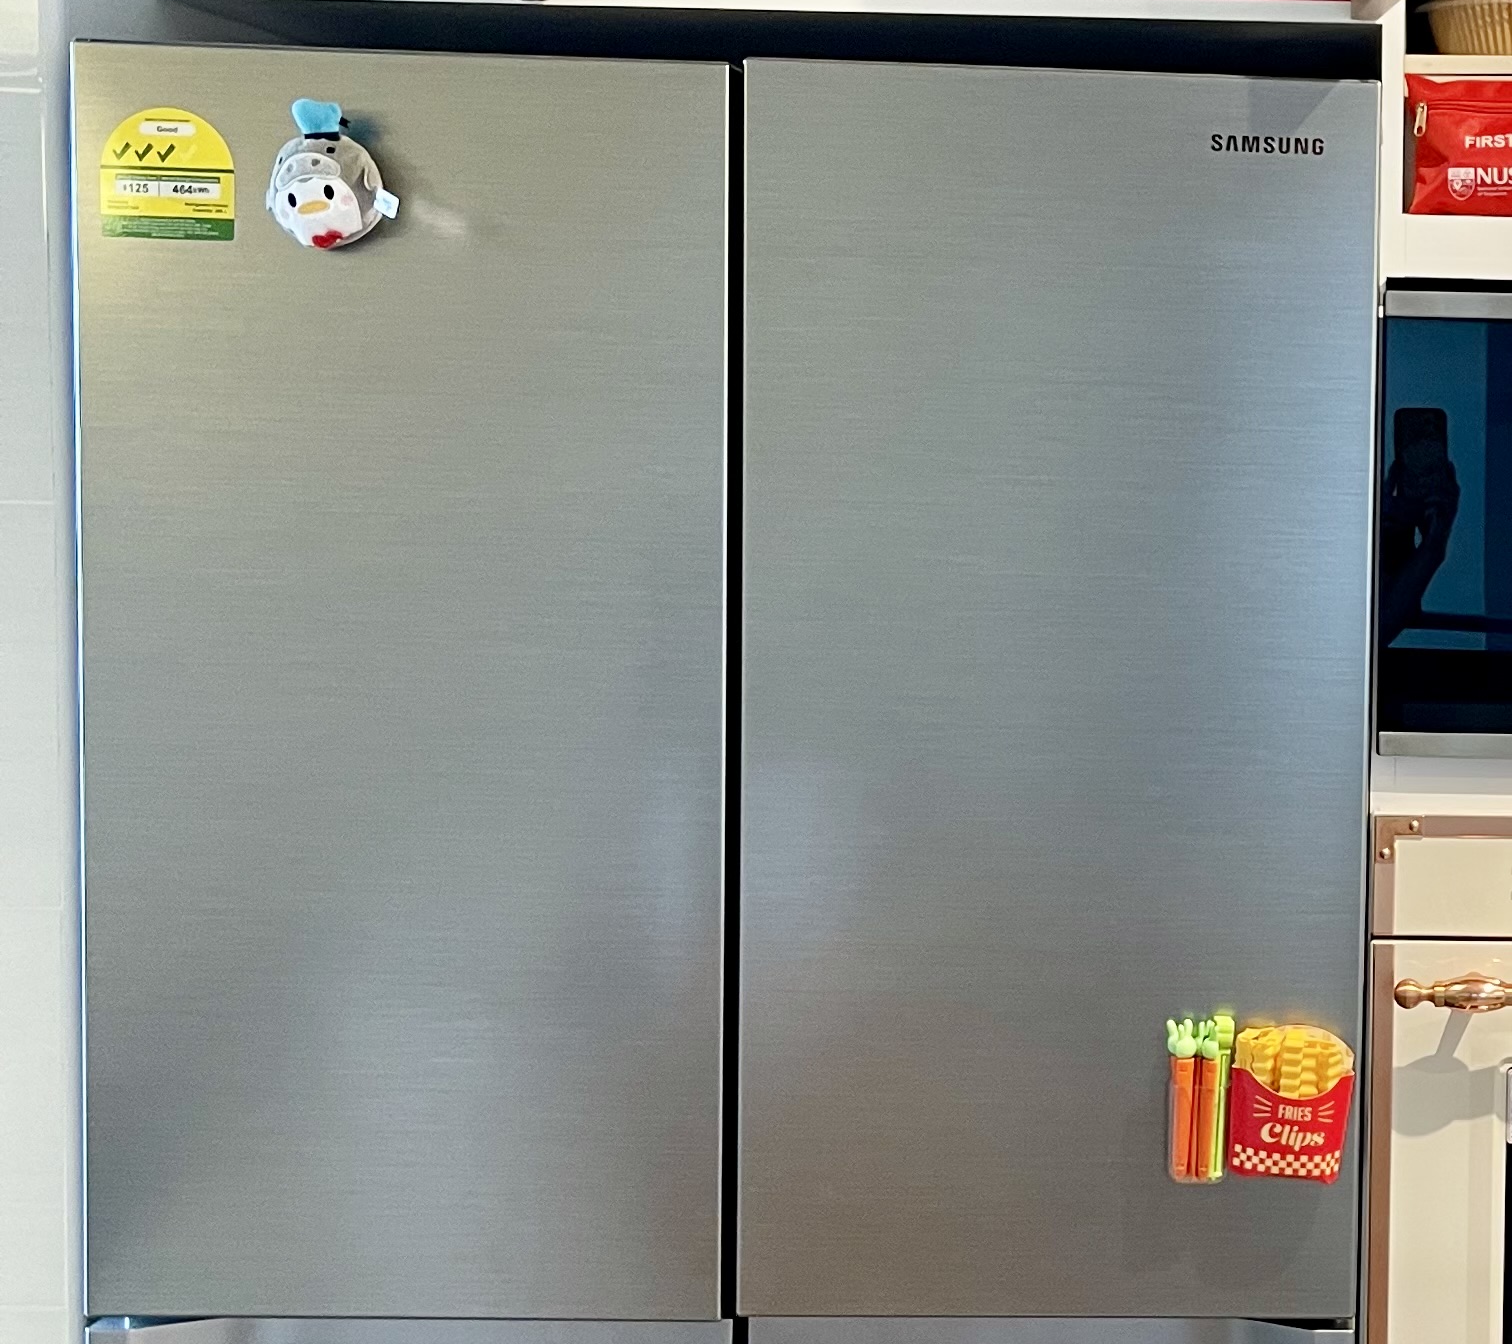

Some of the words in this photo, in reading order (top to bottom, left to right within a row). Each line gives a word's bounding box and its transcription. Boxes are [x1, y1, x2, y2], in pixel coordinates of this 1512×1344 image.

[156, 125, 178, 134] Good
[1210, 134, 1325, 155] SAMSUNG
[1277, 1104, 1313, 1122] FRIES
[1260, 1122, 1326, 1151] Clips
